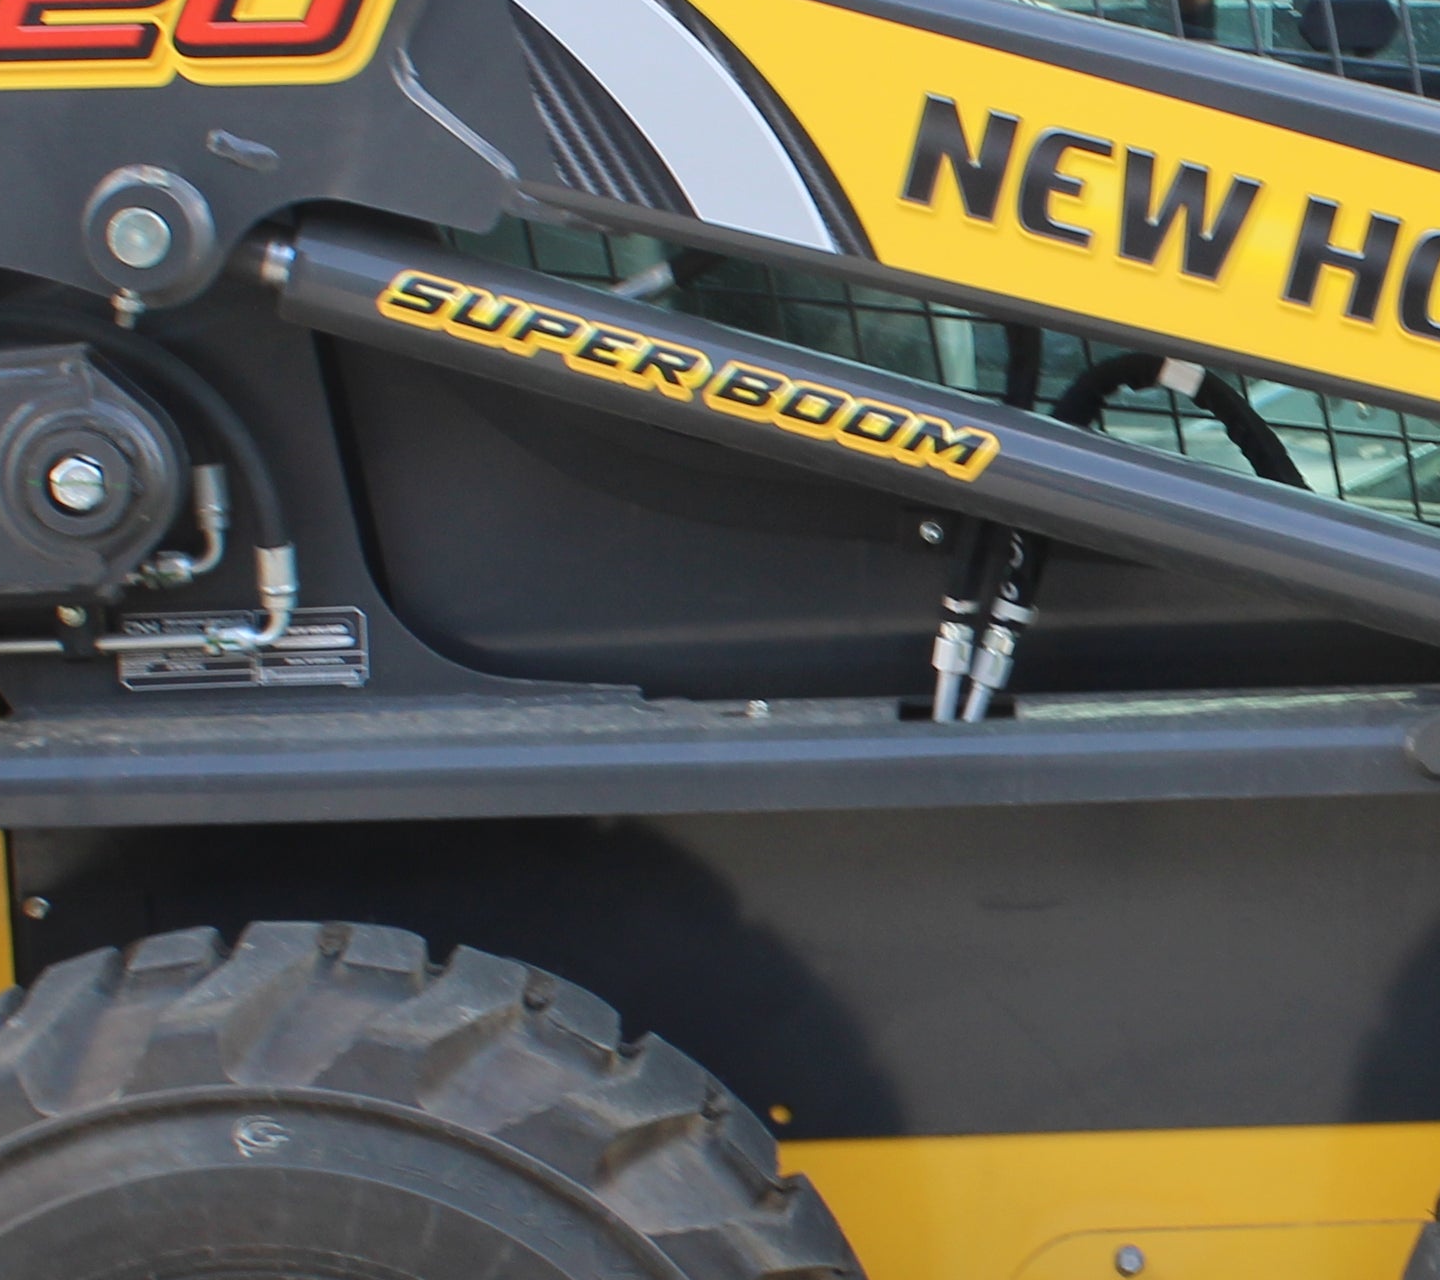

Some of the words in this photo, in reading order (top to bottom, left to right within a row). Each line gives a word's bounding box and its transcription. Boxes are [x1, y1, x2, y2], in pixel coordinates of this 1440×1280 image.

[898, 91, 1264, 284] NEW
[382, 272, 710, 398] SUPER
[706, 362, 1000, 477] BOOM
